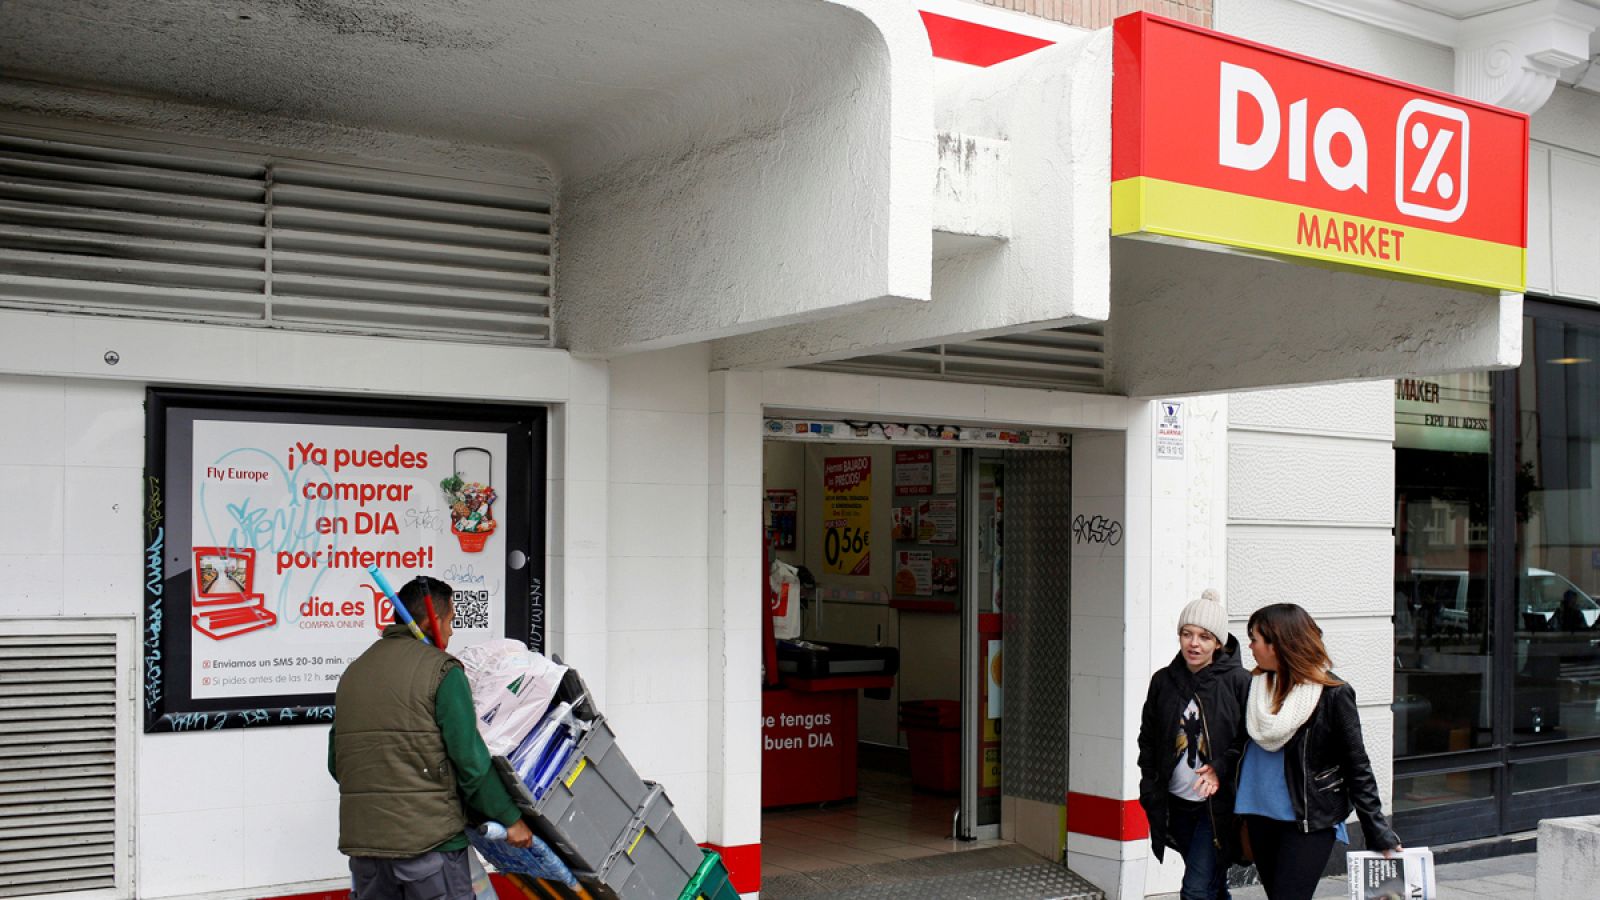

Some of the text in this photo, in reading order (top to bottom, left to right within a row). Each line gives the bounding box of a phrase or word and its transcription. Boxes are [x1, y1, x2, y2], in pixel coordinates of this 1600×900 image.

[1219, 61, 1368, 194] Dia
[1296, 212, 1404, 261] MARKET
[1396, 378, 1440, 404] MAKER
[1425, 414, 1488, 431] EXPO ALL ACCESS
[288, 442, 428, 472] ¡Ya puedes
[843, 457, 868, 473] BAJADO
[207, 467, 269, 482] Fly Europe
[302, 482, 413, 506] comprar
[315, 515, 348, 534] en
[355, 512, 400, 535] DIA
[277, 545, 433, 575] por internet!
[300, 597, 364, 617] dia.es
[300, 620, 364, 629] COMPRA ONLINE
[212, 659, 257, 669] Enviamos
[259, 659, 271, 667] un
[273, 658, 293, 667] SMS
[296, 656, 323, 666] 20-30
[325, 655, 344, 665] min.
[212, 677, 220, 686] Si
[222, 675, 247, 686] pides
[249, 674, 272, 684] antes
[275, 673, 287, 683] de
[289, 673, 301, 682] las
[303, 672, 312, 681] 12
[780, 712, 832, 729] tengas
[765, 732, 834, 750] buen DIA
